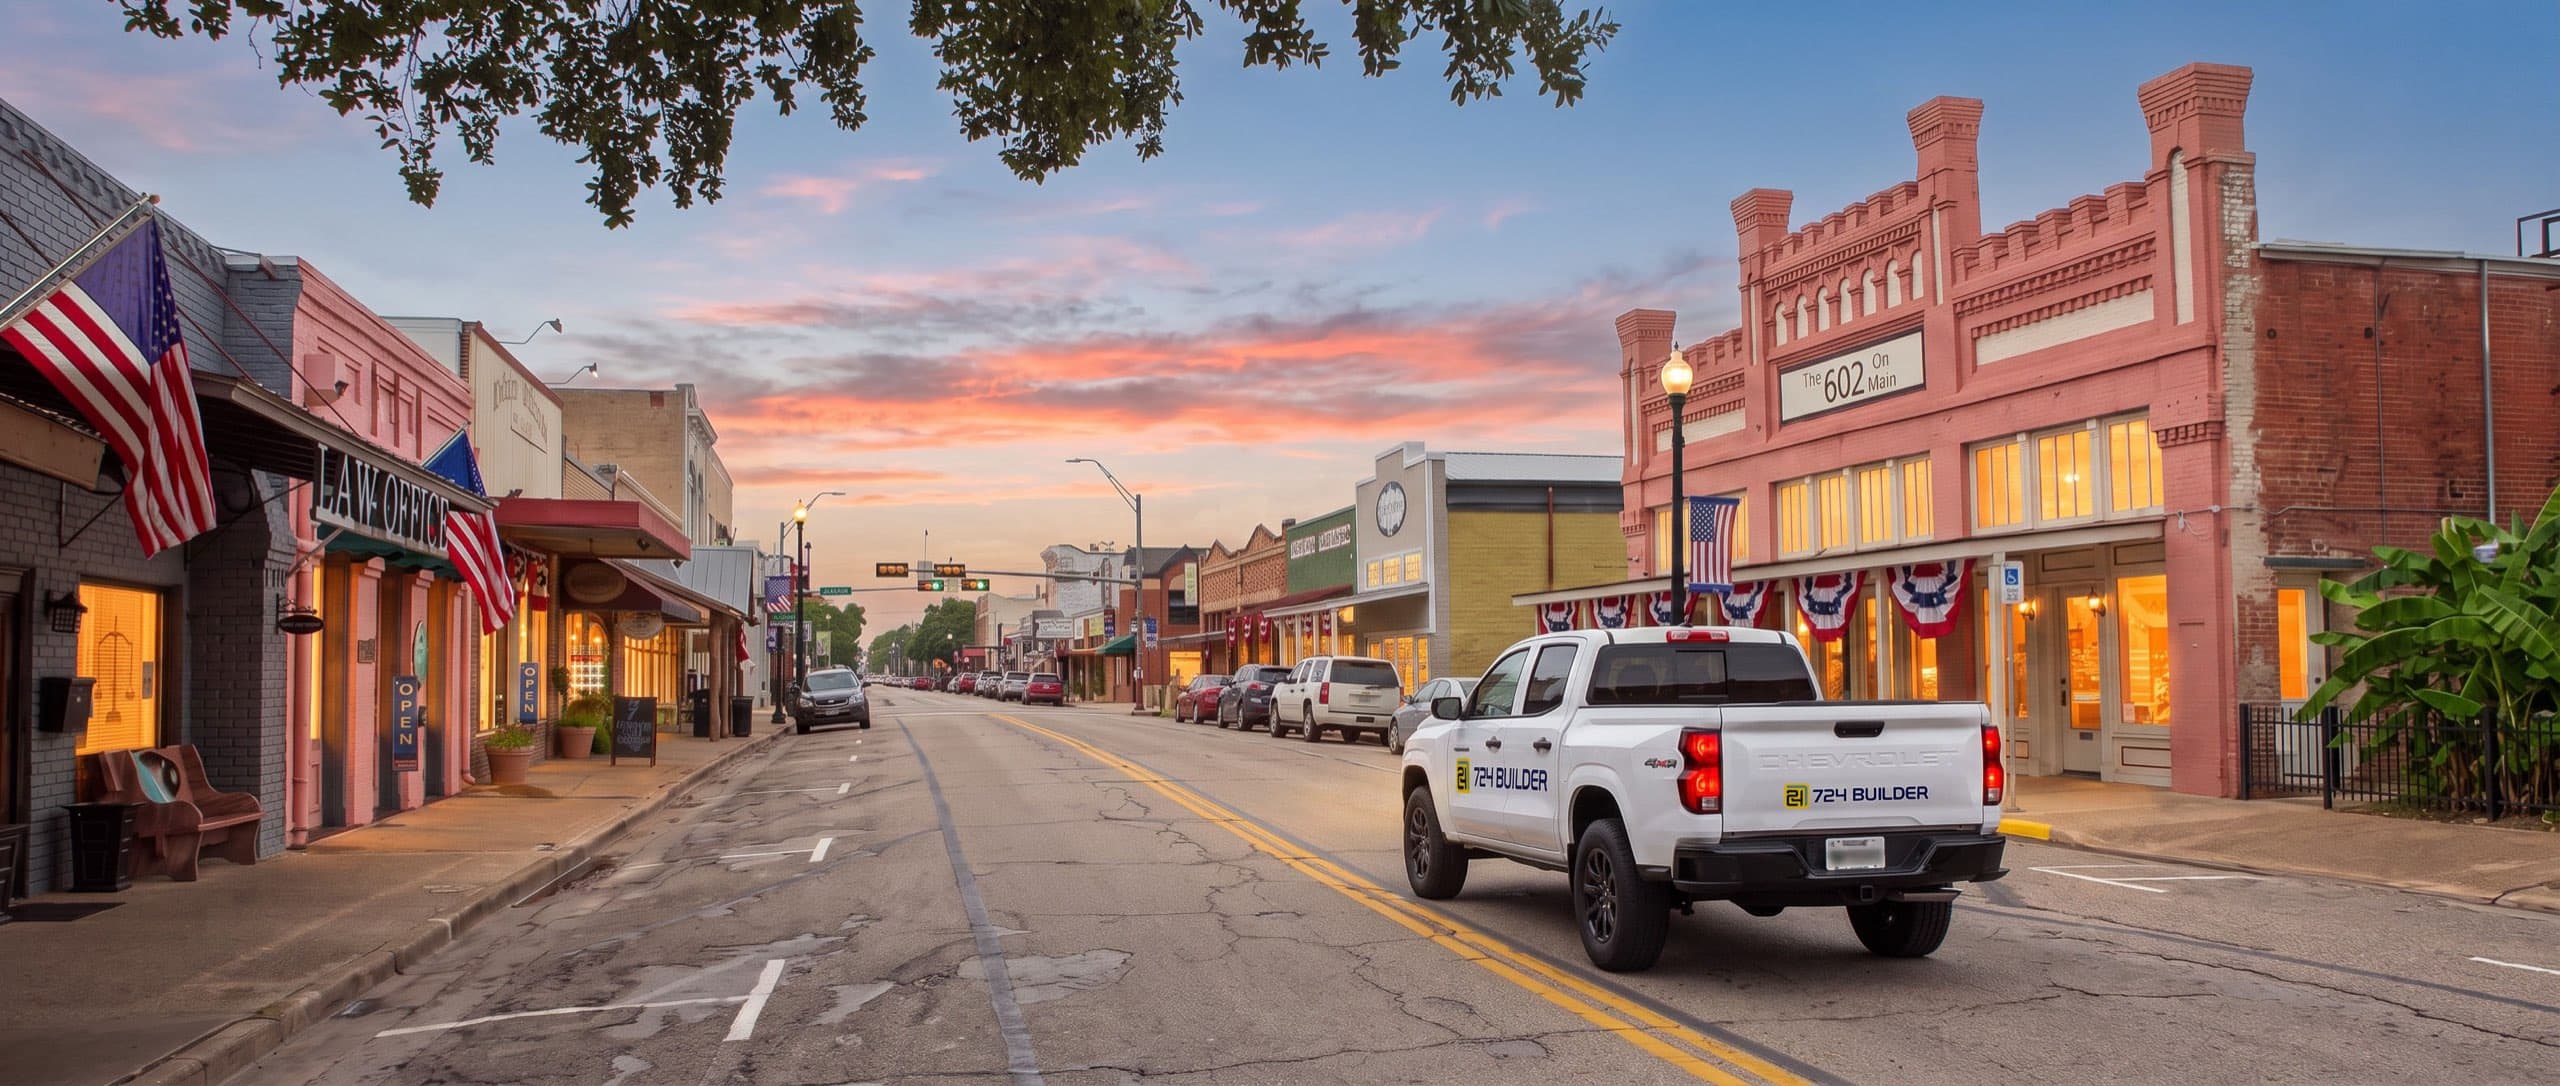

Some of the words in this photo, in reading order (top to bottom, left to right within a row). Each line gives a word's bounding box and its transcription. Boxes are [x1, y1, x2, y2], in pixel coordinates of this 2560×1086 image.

[1872, 352, 1889, 369] On
[1803, 372, 1822, 389] The
[1824, 360, 1865, 403] 602
[1868, 371, 1897, 393] Main
[318, 443, 380, 529] LAW
[384, 473, 449, 551] OFFICE
[524, 666, 536, 713] OPEN
[399, 683, 414, 745] OPEN
[1758, 750, 1961, 770] CHEVROLET
[1473, 766, 1494, 788] 724
[1496, 767, 1548, 792] BUILDER
[1812, 787, 1847, 804] 724
[1852, 785, 1929, 803] BUILDER
